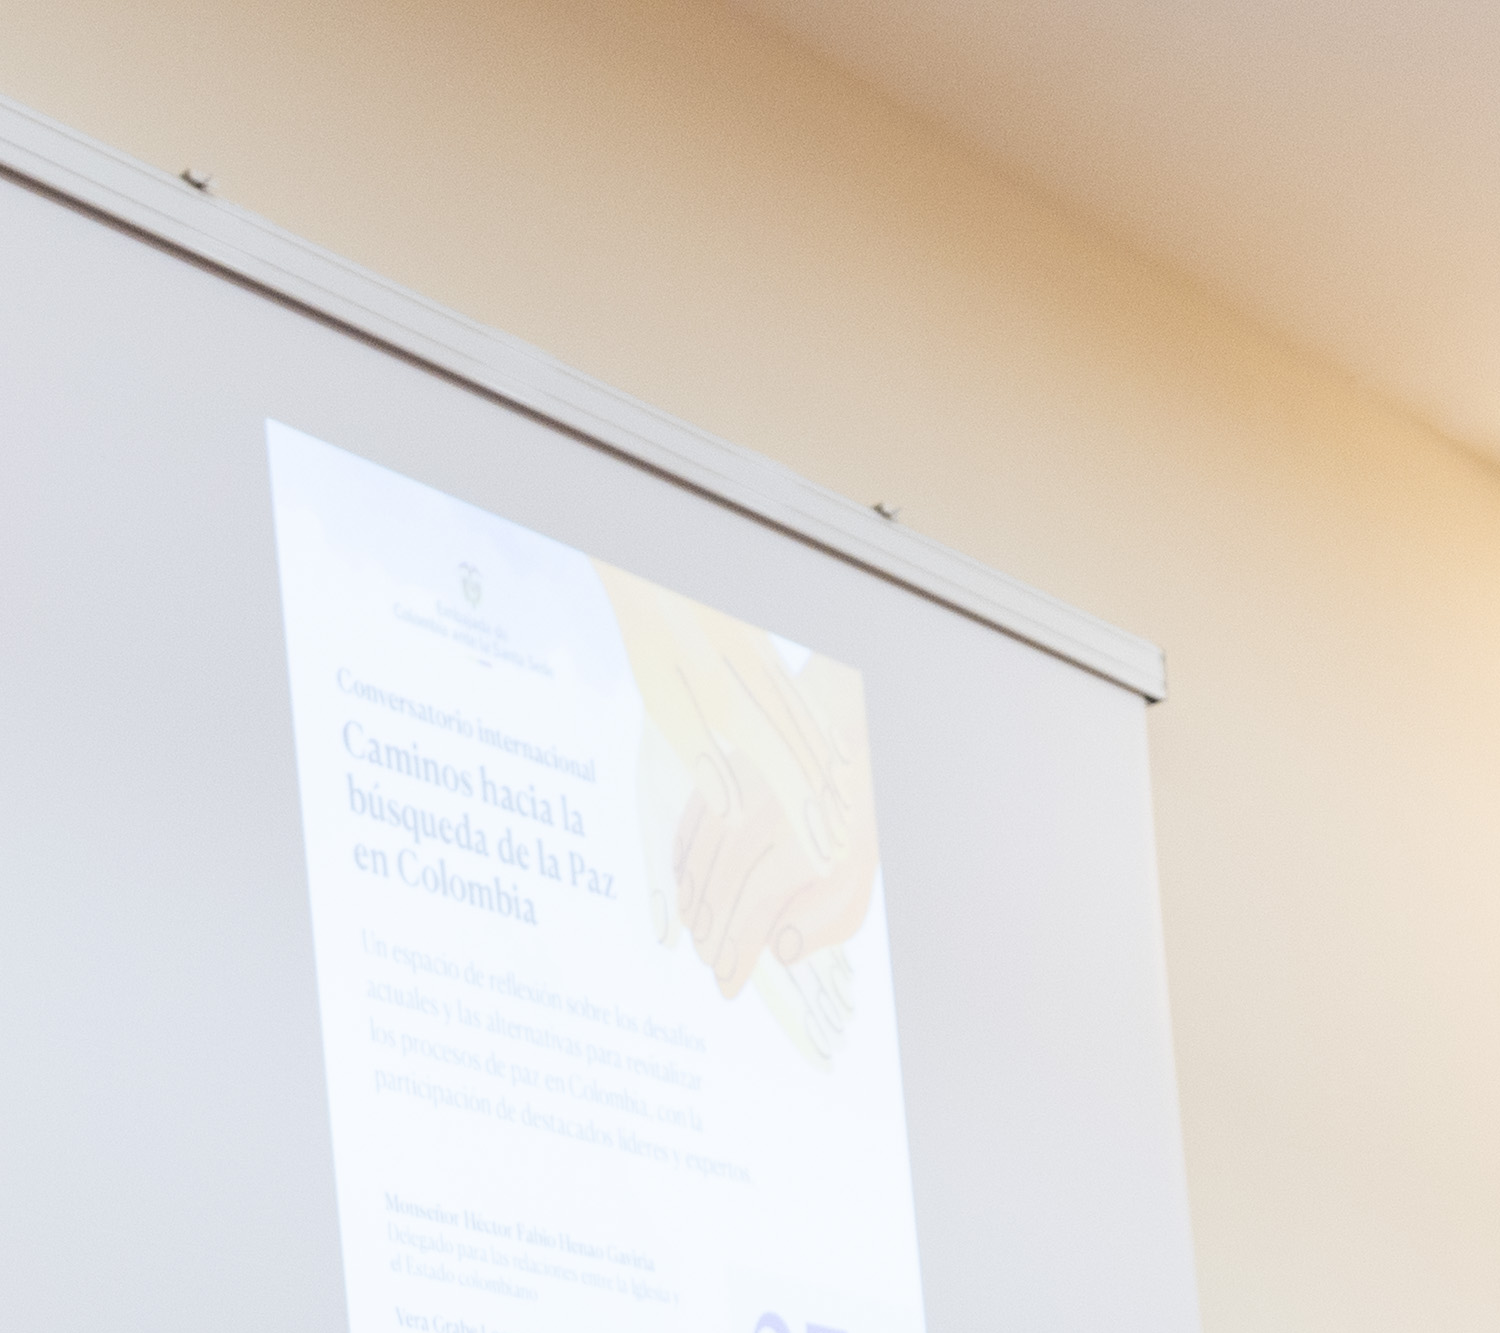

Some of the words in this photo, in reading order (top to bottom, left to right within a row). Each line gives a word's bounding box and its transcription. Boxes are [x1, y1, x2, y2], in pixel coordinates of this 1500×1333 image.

[341, 720, 473, 796] Caminos
[479, 765, 554, 826] hacia
[560, 795, 585, 837] la
[477, 718, 596, 784] internacional
[345, 772, 489, 857] búsqueda
[497, 827, 529, 871] de
[536, 838, 562, 882] la
[569, 851, 616, 899] Paz
[353, 844, 389, 878] en
[396, 849, 538, 926] Colombia
